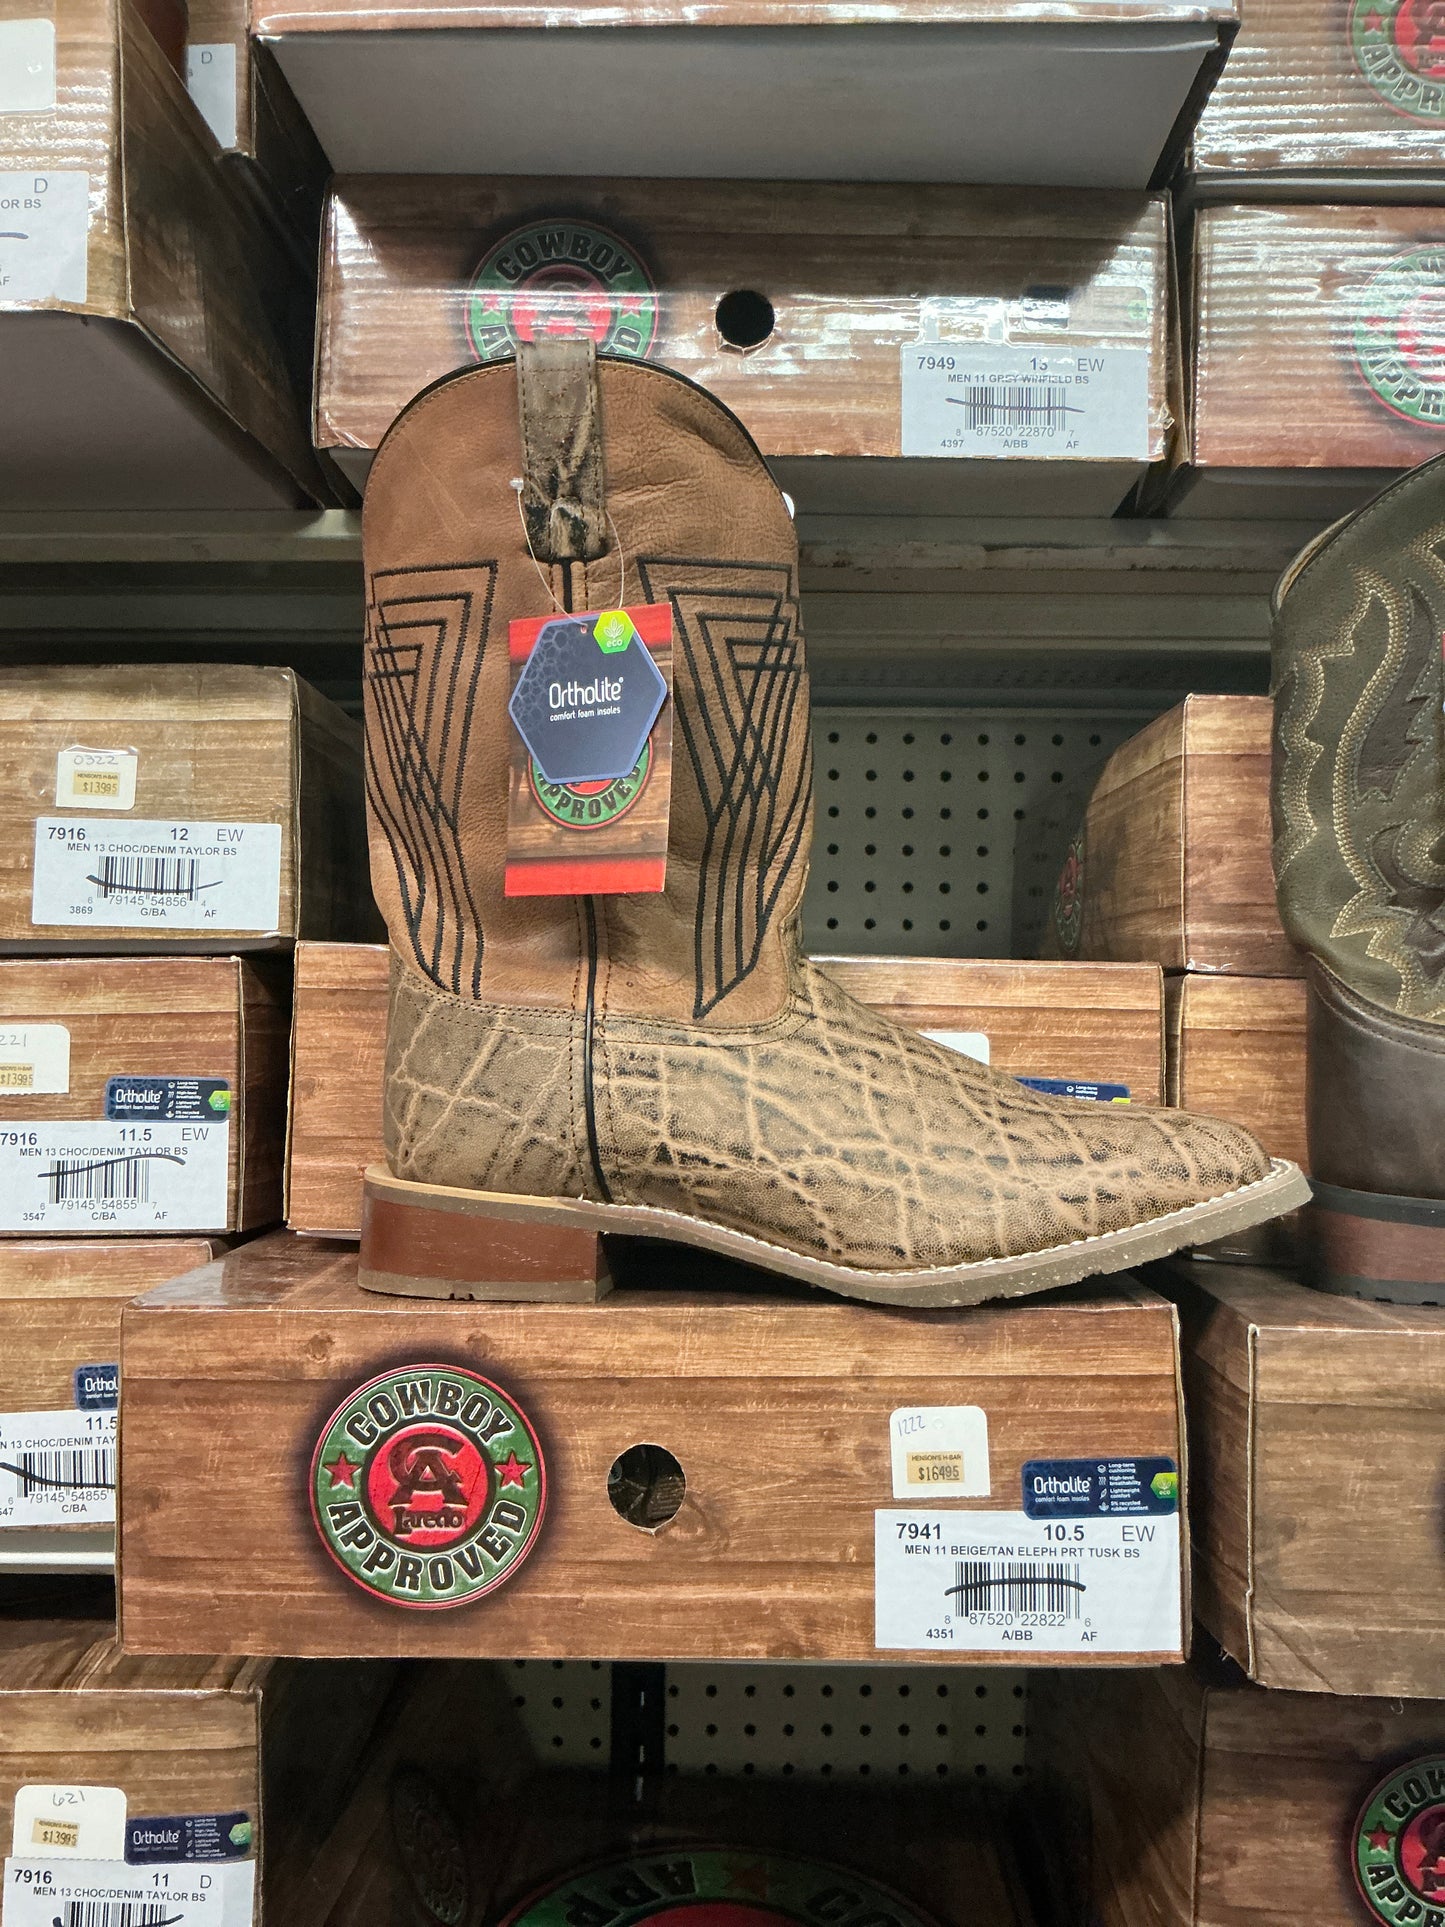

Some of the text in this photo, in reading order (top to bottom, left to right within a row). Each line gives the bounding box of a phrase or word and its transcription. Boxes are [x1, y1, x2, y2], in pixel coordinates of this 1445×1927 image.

[201, 51, 213, 64] D
[34, 178, 48, 194] D
[24, 198, 42, 209] BS
[494, 231, 634, 284] COWBOY
[916, 356, 956, 370] 7949
[1077, 358, 1105, 372] EW
[947, 374, 971, 383] MEN
[975, 374, 986, 383] 11
[1076, 375, 1090, 384] BS
[976, 426, 1012, 438] 87520
[1018, 426, 1054, 438] 22870
[1070, 430, 1074, 438] 7
[940, 440, 1079, 448] 4397 A/BB AF
[606, 640, 622, 648] eco
[550, 705, 621, 722] comfort foam insoles
[74, 754, 119, 766] 0322
[48, 827, 244, 842] 7916 12 EW
[68, 842, 237, 856] MEN 13 CHOC/DENIM TAYLOR BS
[108, 895, 144, 906] 79145
[151, 896, 187, 907] 54856
[70, 906, 216, 918] 3869 G/BA AF
[0, 1128, 210, 1146] 7916 11.5 EW
[20, 1147, 188, 1156] MEN 13 CHOC/DENIM TAYLOR BS
[60, 1200, 95, 1210] 79145
[101, 1200, 137, 1210] 54855
[22, 1212, 168, 1221] 3547 C/BA AF
[344, 1379, 515, 1446] COWBOY
[86, 1416, 118, 1430] 11.5
[898, 1416, 926, 1437] 1222
[11, 1440, 22, 1449] 13
[25, 1437, 93, 1448] CHOC/DENIM
[29, 1492, 65, 1504] 79145
[71, 1490, 108, 1502] 54855
[62, 1504, 87, 1513] C/BA
[896, 1523, 1156, 1542] 7941 10.5 EW
[326, 1500, 527, 1592] APPROVED
[904, 1545, 1140, 1558] MEN 11 BEIGE/TAN ELEPH PRT TUSK BS
[944, 1613, 1091, 1627] 8 87520 22822 6
[926, 1628, 1098, 1642] 4351 A/BB AF
[14, 1869, 212, 1888] 7916 11 D
[34, 1887, 206, 1902] MEN 13 CHOC/DENIM TAYLOR BS
